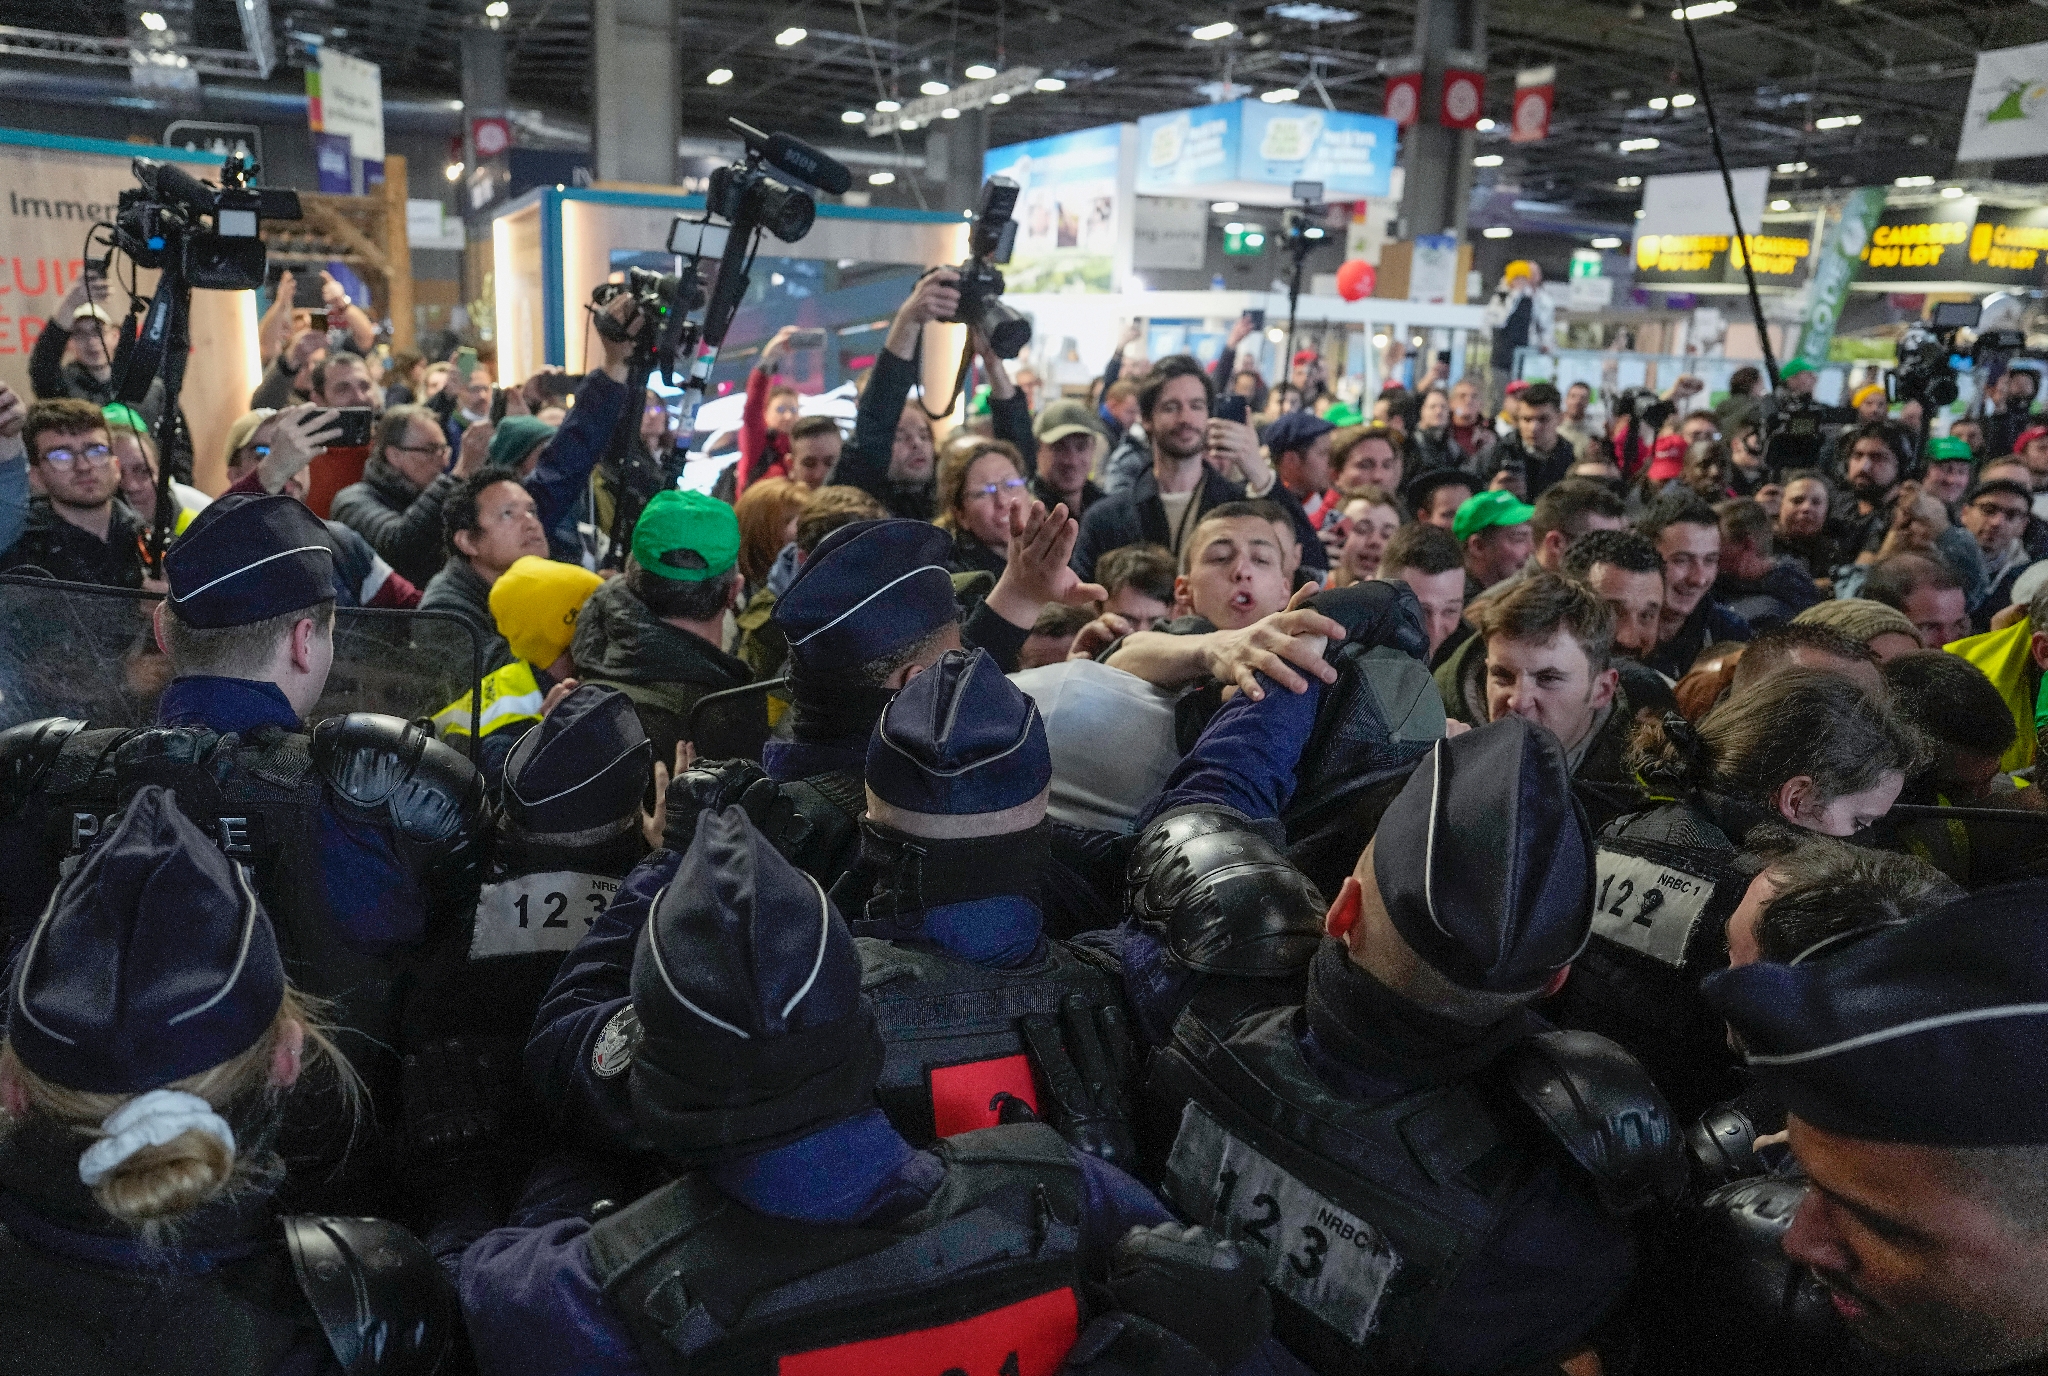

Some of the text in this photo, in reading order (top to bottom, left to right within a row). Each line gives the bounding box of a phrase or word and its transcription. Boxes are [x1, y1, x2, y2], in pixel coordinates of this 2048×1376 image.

[10, 190, 118, 221] Immer
[591, 879, 619, 893] NRB
[1656, 873, 1692, 894] NRBC
[1317, 1206, 1369, 1249] NRBC
